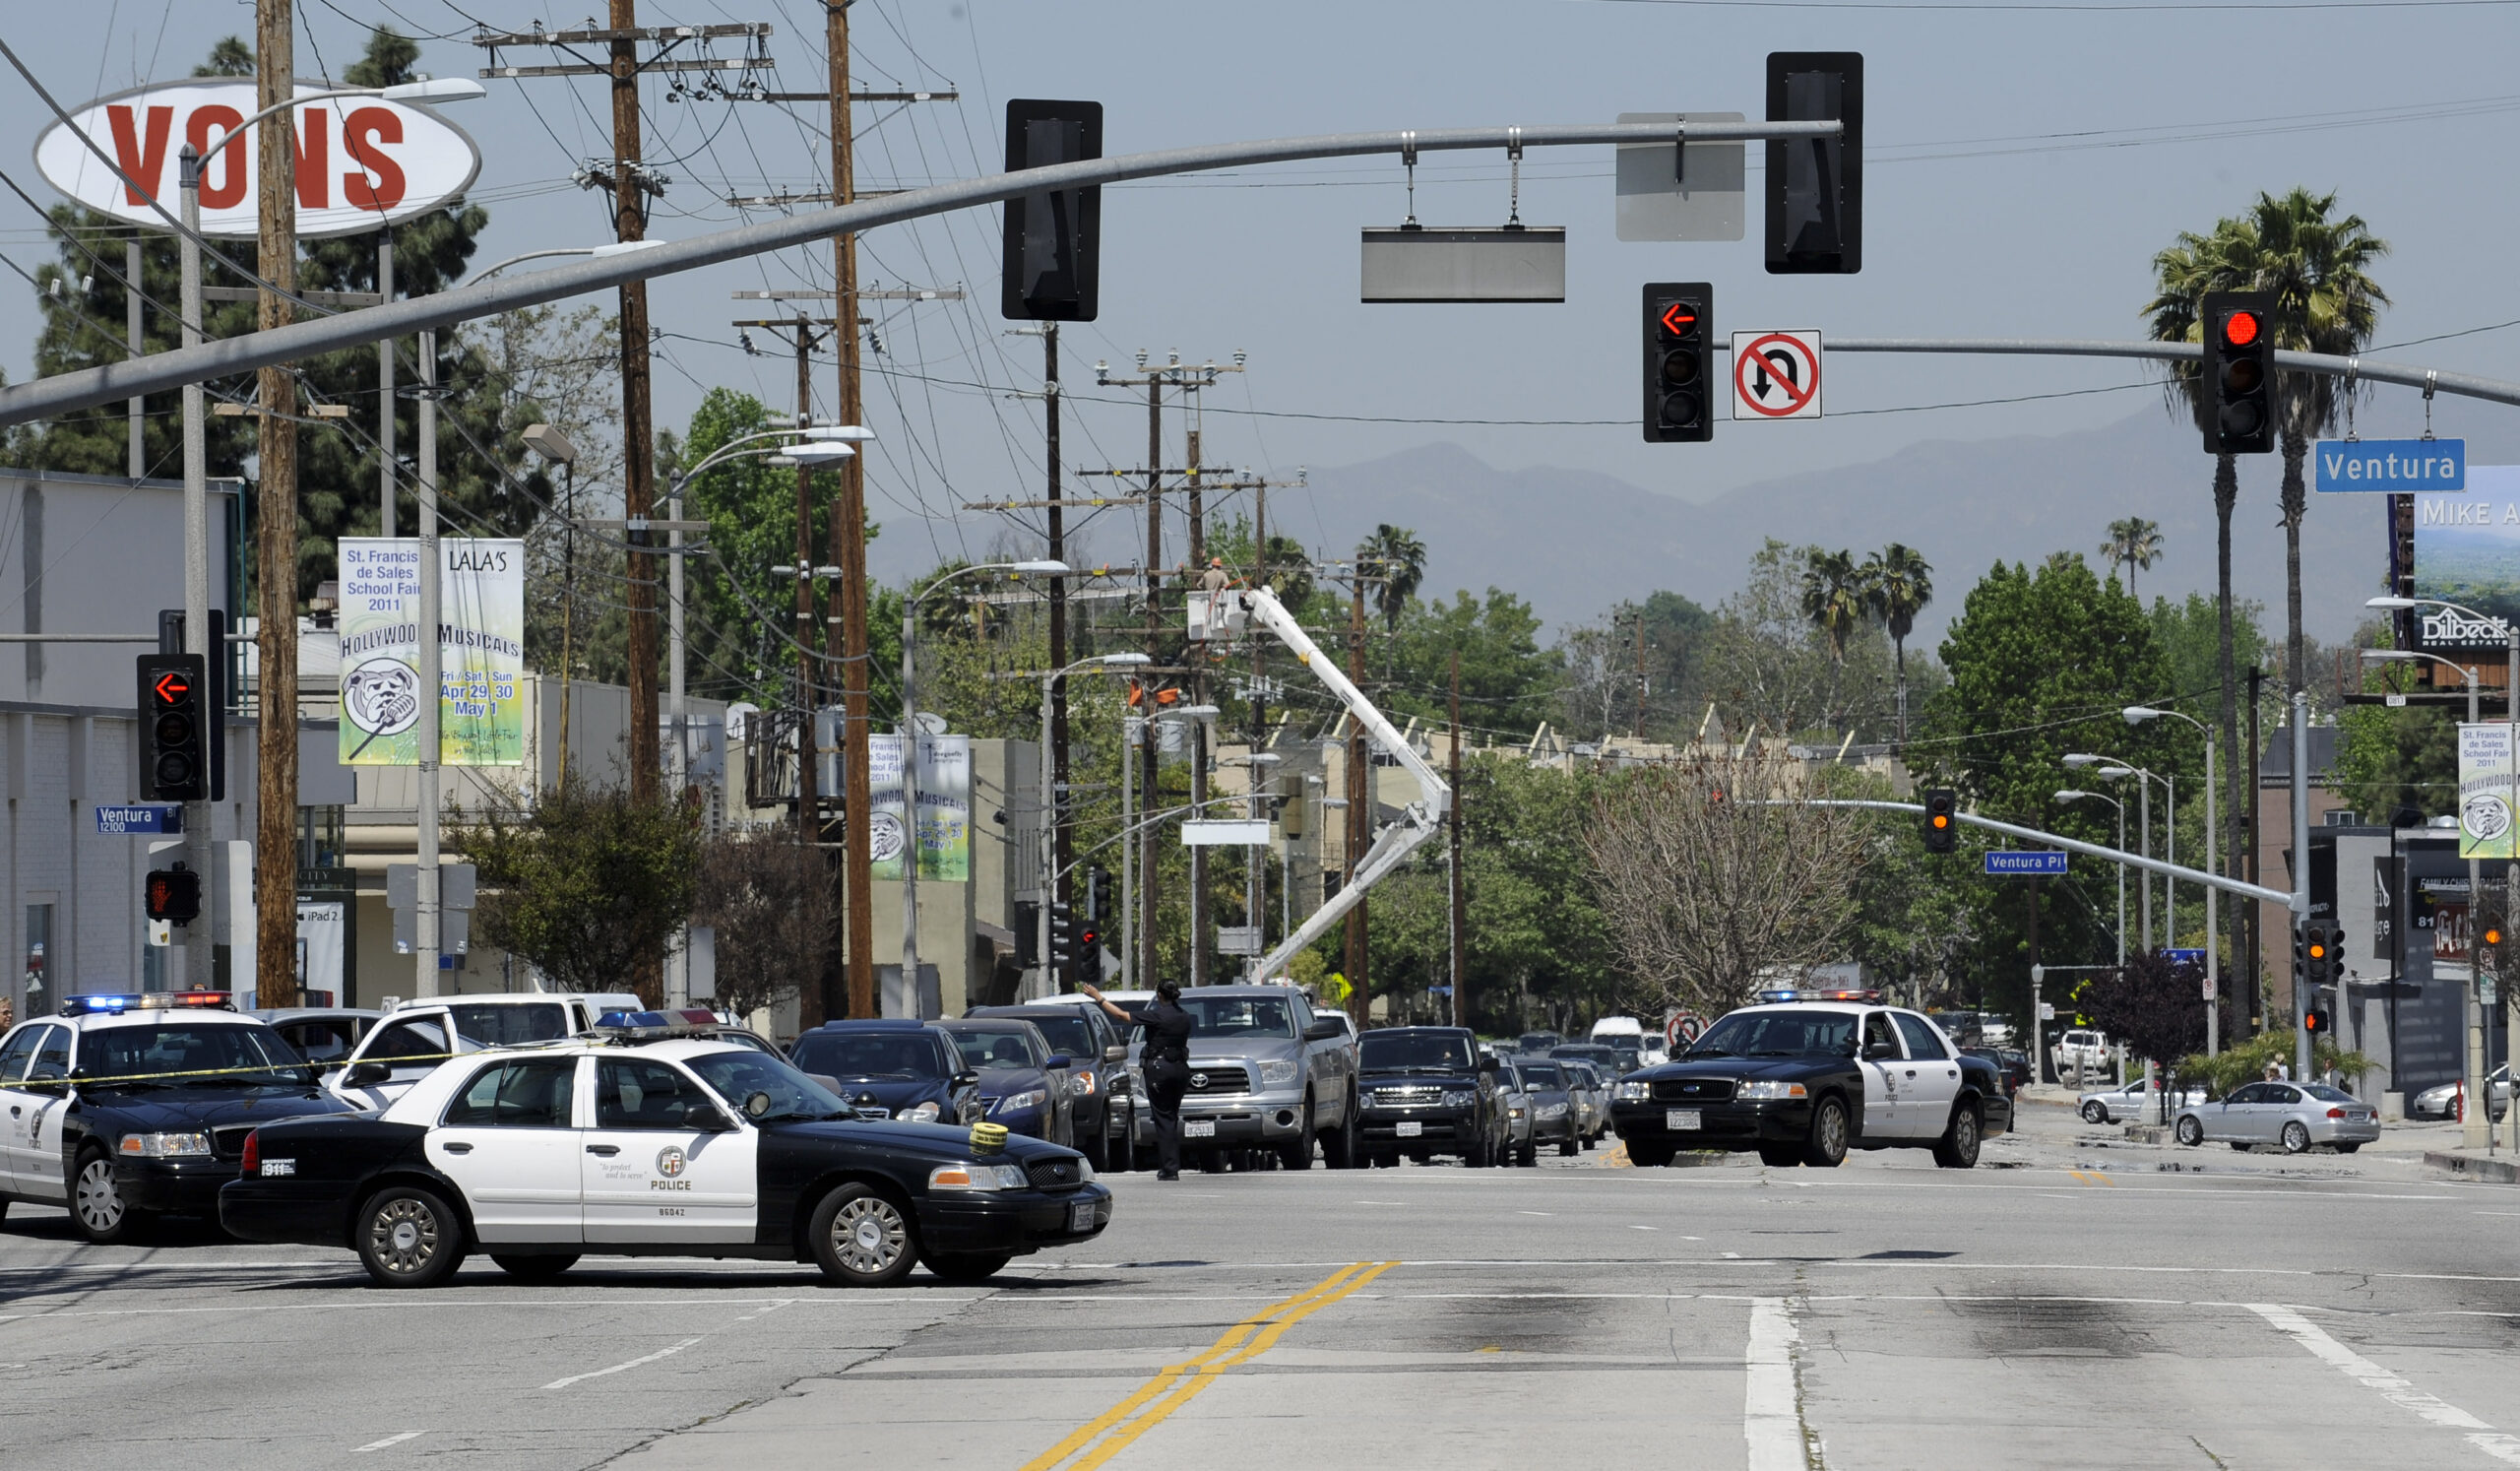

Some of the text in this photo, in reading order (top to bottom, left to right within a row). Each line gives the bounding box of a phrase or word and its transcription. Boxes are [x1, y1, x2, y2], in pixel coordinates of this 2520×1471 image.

[106, 104, 406, 211] VONS
[2324, 452, 2455, 480] Ventura
[2423, 500, 2490, 525] MIKE
[347, 550, 418, 562] St. Francis
[449, 551, 506, 571] LALA'S
[357, 567, 413, 579] de Sales
[347, 583, 393, 595] School
[368, 599, 400, 610] 2011
[2423, 612, 2508, 640] Dilbeck
[342, 623, 519, 658] HOLLYWOO MUSICALS
[441, 672, 454, 681] Fri
[465, 672, 481, 681] Sat
[492, 672, 513, 681] Sun
[440, 685, 465, 700] Apr
[496, 685, 513, 698] 30
[455, 701, 497, 717] May 1
[100, 808, 152, 822] Ventura
[100, 821, 125, 832] 12100
[1991, 857, 2061, 868] Ventura Pl
[298, 870, 330, 881] CITY
[308, 912, 338, 921] iPad 2
[266, 1164, 284, 1177] 911
[651, 1181, 691, 1190] POLICE
